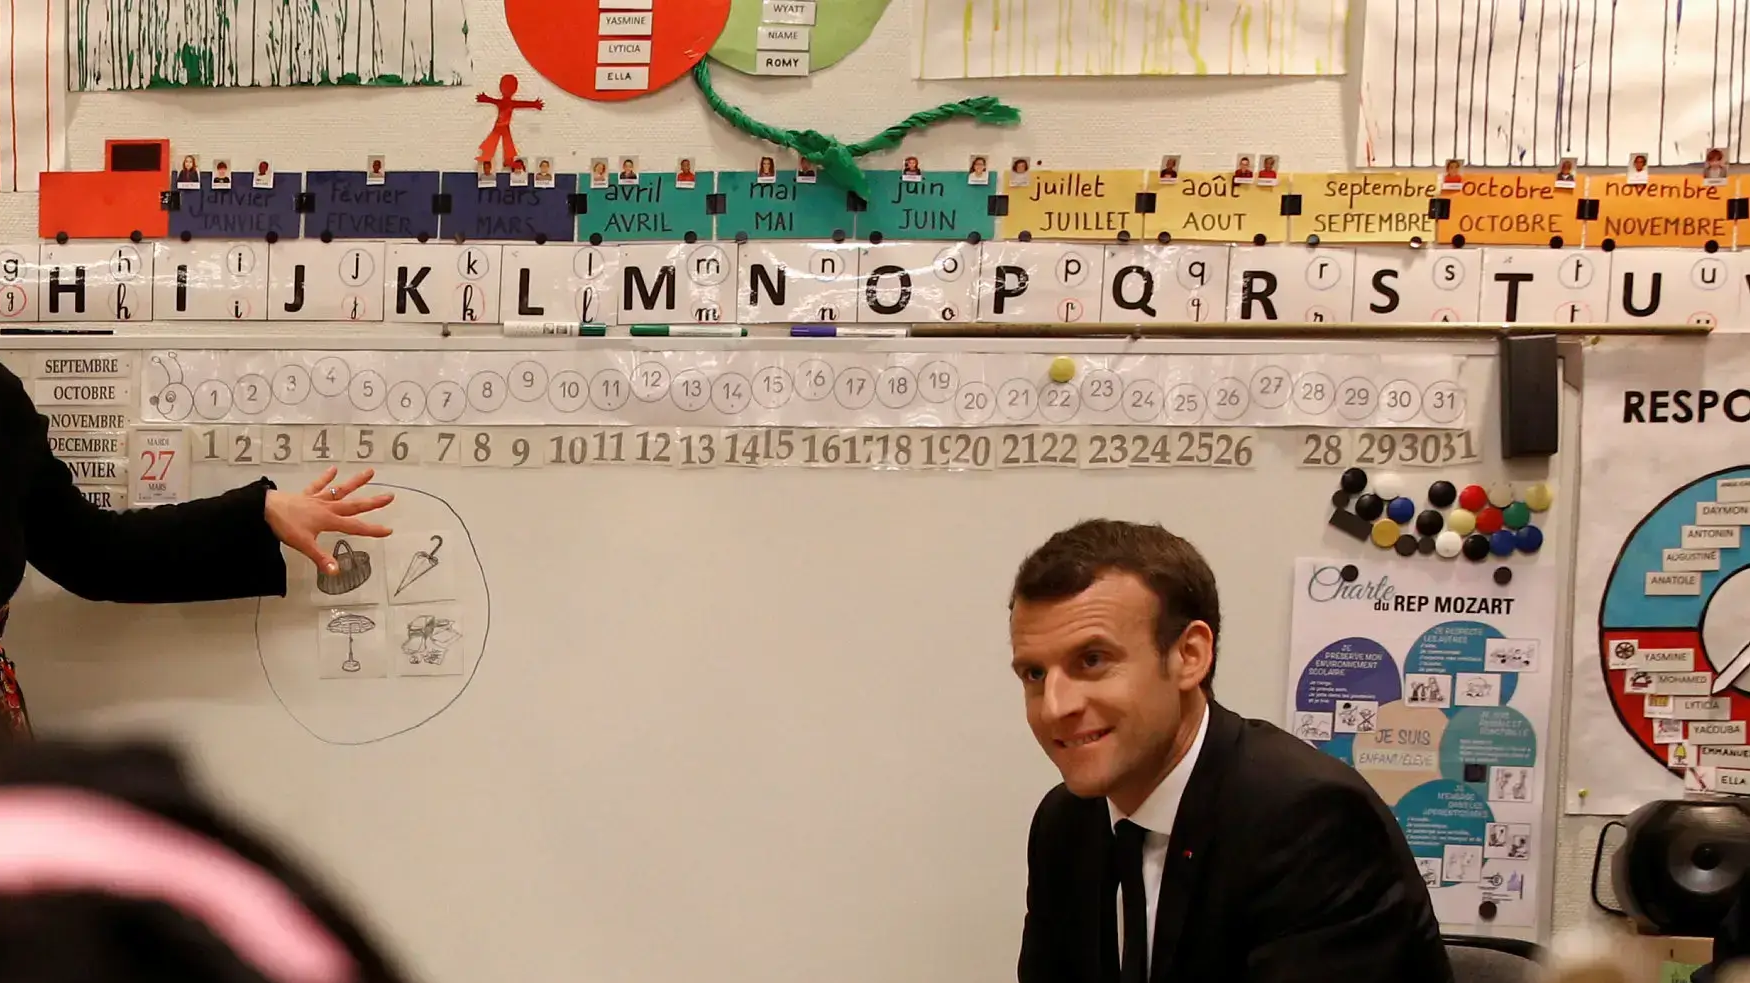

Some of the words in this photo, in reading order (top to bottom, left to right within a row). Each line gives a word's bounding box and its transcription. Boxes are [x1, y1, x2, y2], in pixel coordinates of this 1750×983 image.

[773, 4, 805, 13] WYATT
[605, 16, 646, 25] YASMINE
[768, 31, 799, 40] NIAME
[608, 44, 641, 53] LYTICIA
[765, 58, 799, 68] ROMY
[607, 72, 632, 81] ELLA
[604, 178, 663, 203] avril
[750, 179, 797, 201] mai
[892, 177, 944, 204] juin
[1029, 173, 1106, 201] juillet
[1181, 175, 1240, 198] août
[1324, 176, 1437, 209] septembre
[1462, 177, 1554, 200] octobre
[1605, 180, 1721, 201] novembre
[198, 212, 284, 233] JANVIER
[475, 215, 534, 234] MARS
[604, 211, 673, 232] AVRIL
[754, 211, 795, 231] MAI
[898, 210, 957, 230] JUIN
[1039, 210, 1130, 231] JUILLET
[1183, 212, 1247, 231] AOUT
[1313, 212, 1435, 233] SEPTEMBRE
[1459, 213, 1562, 233] OCTOBRE
[1604, 216, 1727, 237] NOVEMBRE
[50, 266, 85, 313] H
[285, 265, 304, 312] J
[397, 267, 432, 314] K
[519, 268, 545, 315] L
[624, 265, 676, 310] M
[750, 264, 786, 306] N
[866, 265, 912, 315] O
[994, 265, 1030, 315] P
[1112, 265, 1157, 318] Q
[1241, 270, 1278, 320] R
[1370, 269, 1400, 314] S
[1495, 273, 1534, 322] T
[1623, 273, 1662, 318] U
[45, 358, 118, 374] SEPTEMBRE
[54, 386, 115, 400] OCTOBRE
[1623, 389, 1750, 425] RESPO
[51, 413, 124, 428] NOVEMBRE
[49, 437, 117, 452] DECEMBRE
[147, 438, 169, 446] MARDI
[203, 430, 219, 458] 1
[235, 435, 252, 462] 2
[274, 433, 291, 461] 3
[312, 429, 330, 458] 4
[357, 429, 374, 459] 5
[392, 430, 409, 460] 6
[437, 432, 455, 461] 7
[474, 433, 491, 462] 8
[511, 438, 530, 466] 9
[550, 436, 588, 465] 10
[593, 431, 626, 461] 11
[636, 431, 671, 462] 12
[680, 434, 716, 465] 13
[725, 434, 760, 464] 14
[763, 429, 795, 459] 15
[802, 434, 841, 463] 16
[876, 434, 912, 465] 18
[953, 434, 991, 466] 20
[1002, 433, 1038, 464] 21
[1039, 433, 1078, 463] 22
[1088, 434, 1129, 463] 23
[1131, 434, 1171, 463] 24
[1177, 431, 1214, 462] 25
[1214, 434, 1253, 466] 26
[1303, 434, 1341, 465] 28
[1357, 433, 1397, 464] 29
[1399, 433, 1441, 463] 30
[69, 462, 116, 478] NVIER
[140, 450, 175, 481] 27
[1702, 506, 1748, 515] DAYMON
[1687, 530, 1734, 538] ANTONIN
[1666, 551, 1717, 561] AUGUSTINE
[1308, 566, 1396, 602] Charte
[1651, 576, 1695, 585] ANATOLE
[1373, 599, 1390, 612] du
[1394, 595, 1428, 612] REP
[1434, 597, 1515, 615] MOZART
[1644, 652, 1687, 661] YASMINE
[1659, 675, 1707, 683] MOHAMED
[1374, 729, 1394, 744] JE
[1397, 729, 1432, 746] SUIS
[1702, 747, 1750, 758] EMMANUE
[1721, 776, 1747, 785] ELLA
